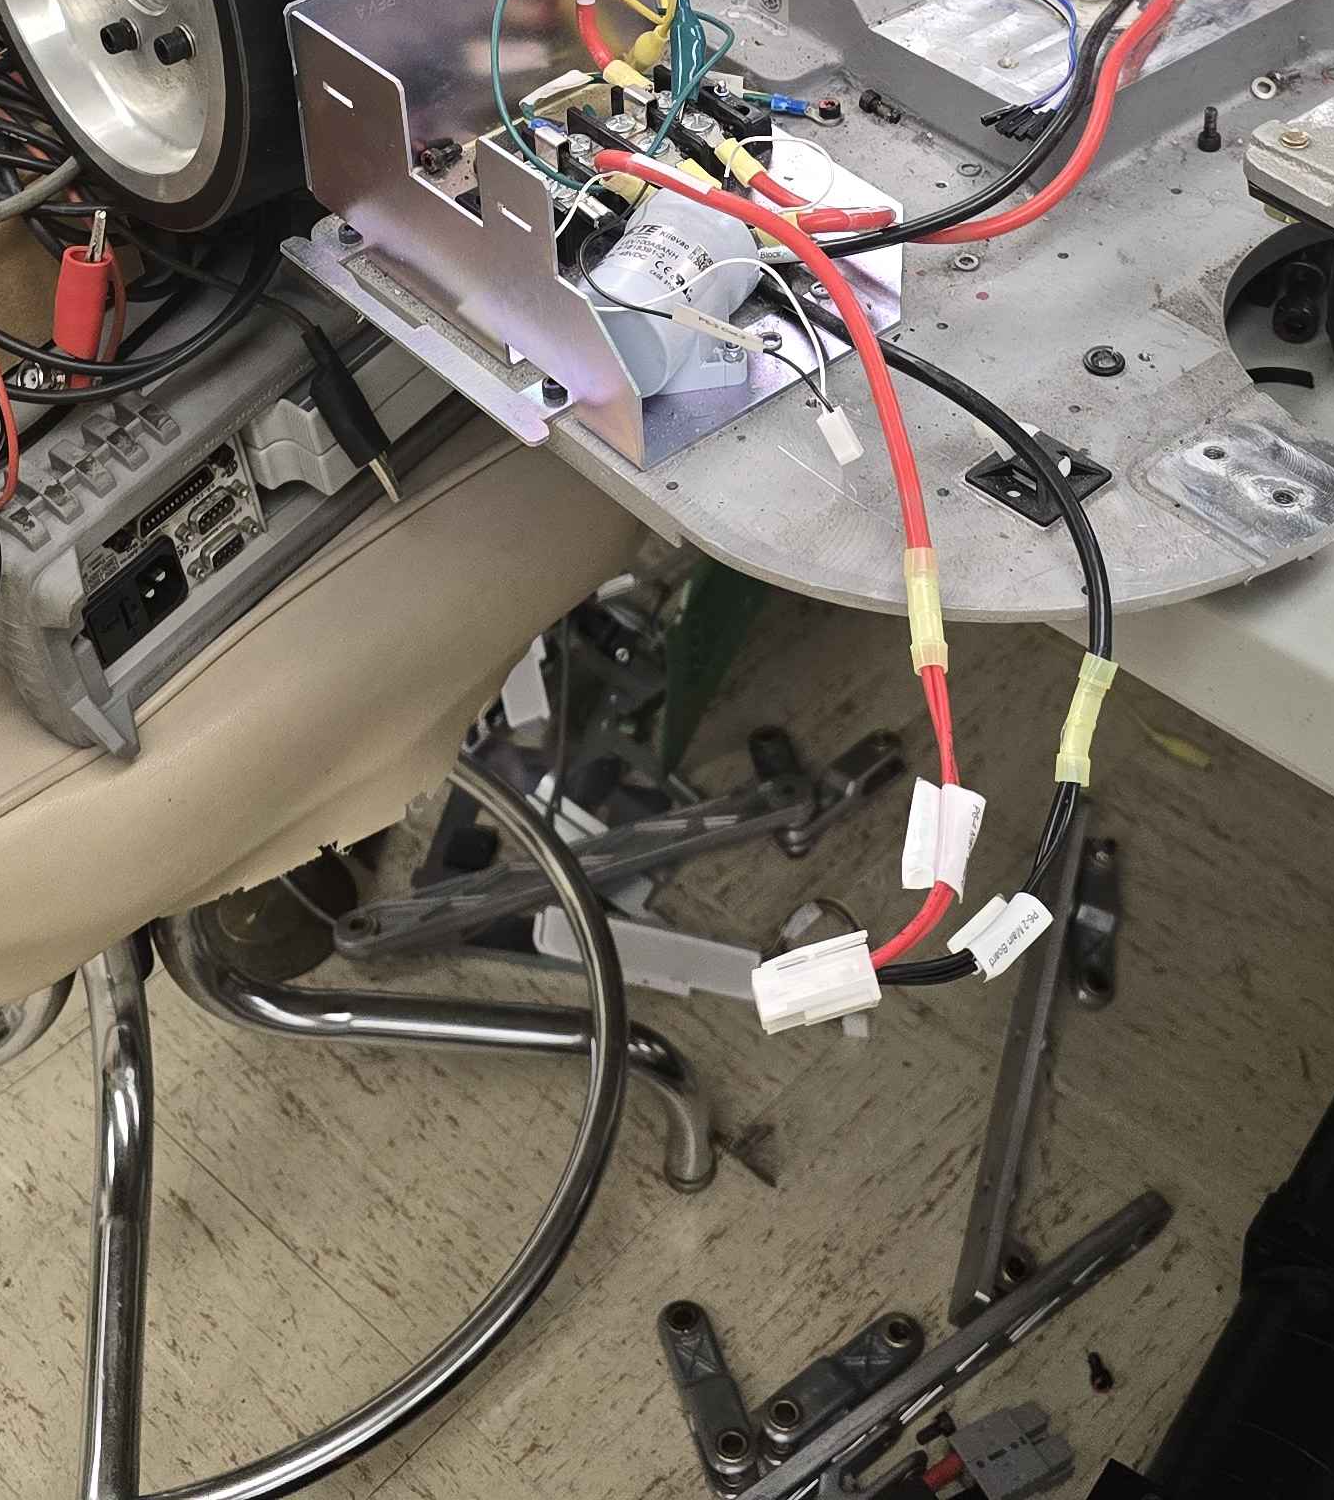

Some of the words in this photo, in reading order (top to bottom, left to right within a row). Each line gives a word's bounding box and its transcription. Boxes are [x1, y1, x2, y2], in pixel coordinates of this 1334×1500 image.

[659, 230, 690, 251] Kilovac
[1007, 921, 1025, 947] Main
[987, 941, 1010, 968] Board
